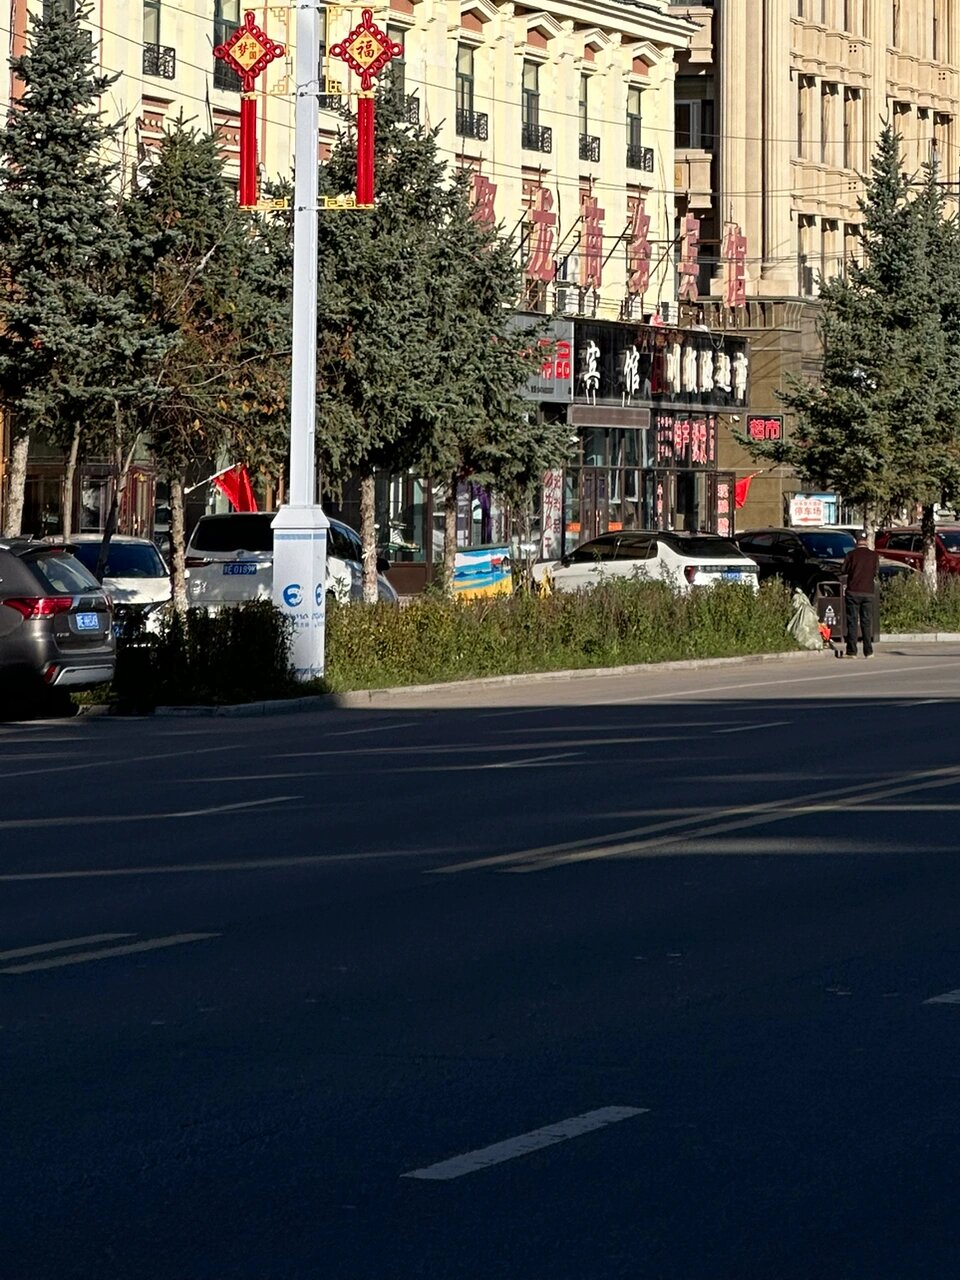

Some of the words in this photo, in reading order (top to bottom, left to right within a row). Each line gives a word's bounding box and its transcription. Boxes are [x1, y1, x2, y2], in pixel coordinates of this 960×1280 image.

[356, 40, 375, 60] 福
[749, 418, 780, 440] 超市
[794, 506, 822, 516] 停车场
